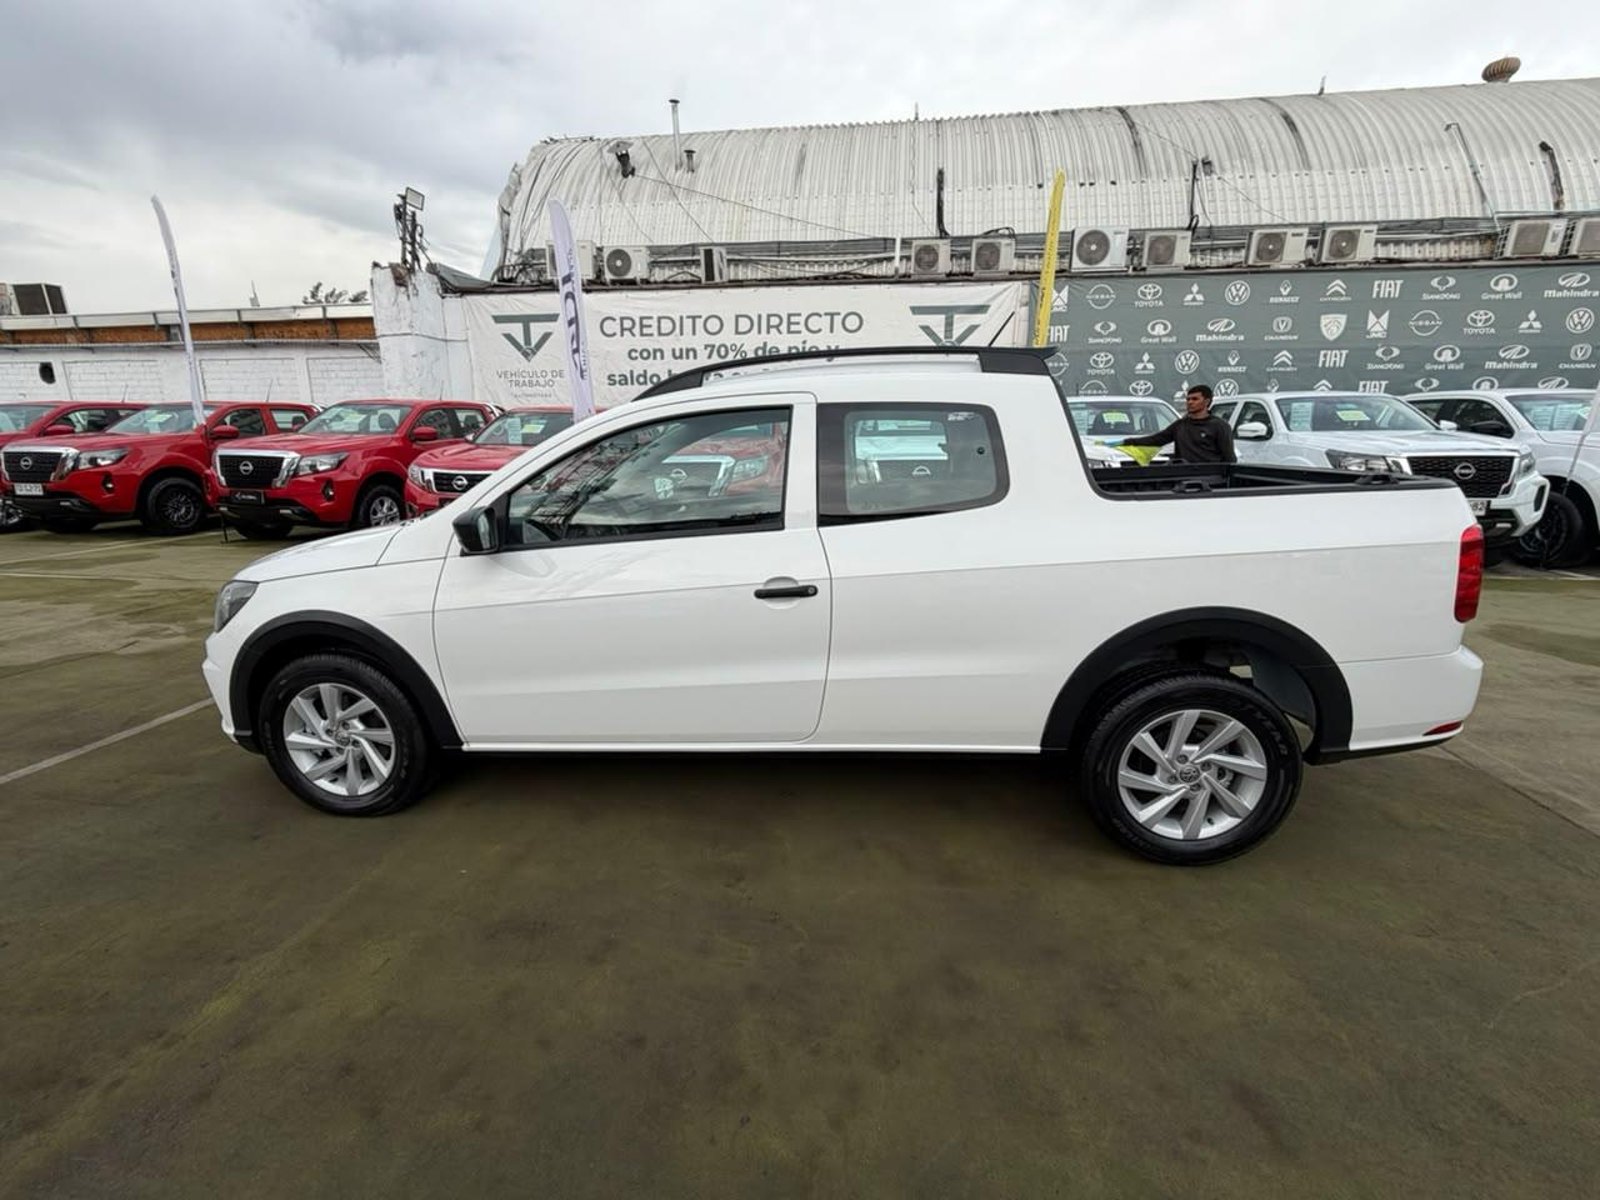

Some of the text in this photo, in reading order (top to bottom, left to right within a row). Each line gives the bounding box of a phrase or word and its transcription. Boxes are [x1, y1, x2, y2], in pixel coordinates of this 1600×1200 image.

[1372, 280, 1404, 298] FIAT
[1481, 292, 1503, 300] Great
[1543, 290, 1599, 298] Mahindra
[599, 311, 864, 338] CREDITO DIRECTO
[1050, 325, 1070, 342] IAT
[628, 347, 664, 360] con
[671, 347, 698, 360] un
[704, 344, 747, 360] 70%
[754, 341, 781, 357] de
[1318, 350, 1349, 368] FIAT
[1484, 361, 1538, 369] Mahindra
[551, 369, 565, 378] DE
[607, 369, 661, 386] saldo
[508, 379, 555, 388] TRABAJO
[1358, 381, 1389, 393] FIAT
